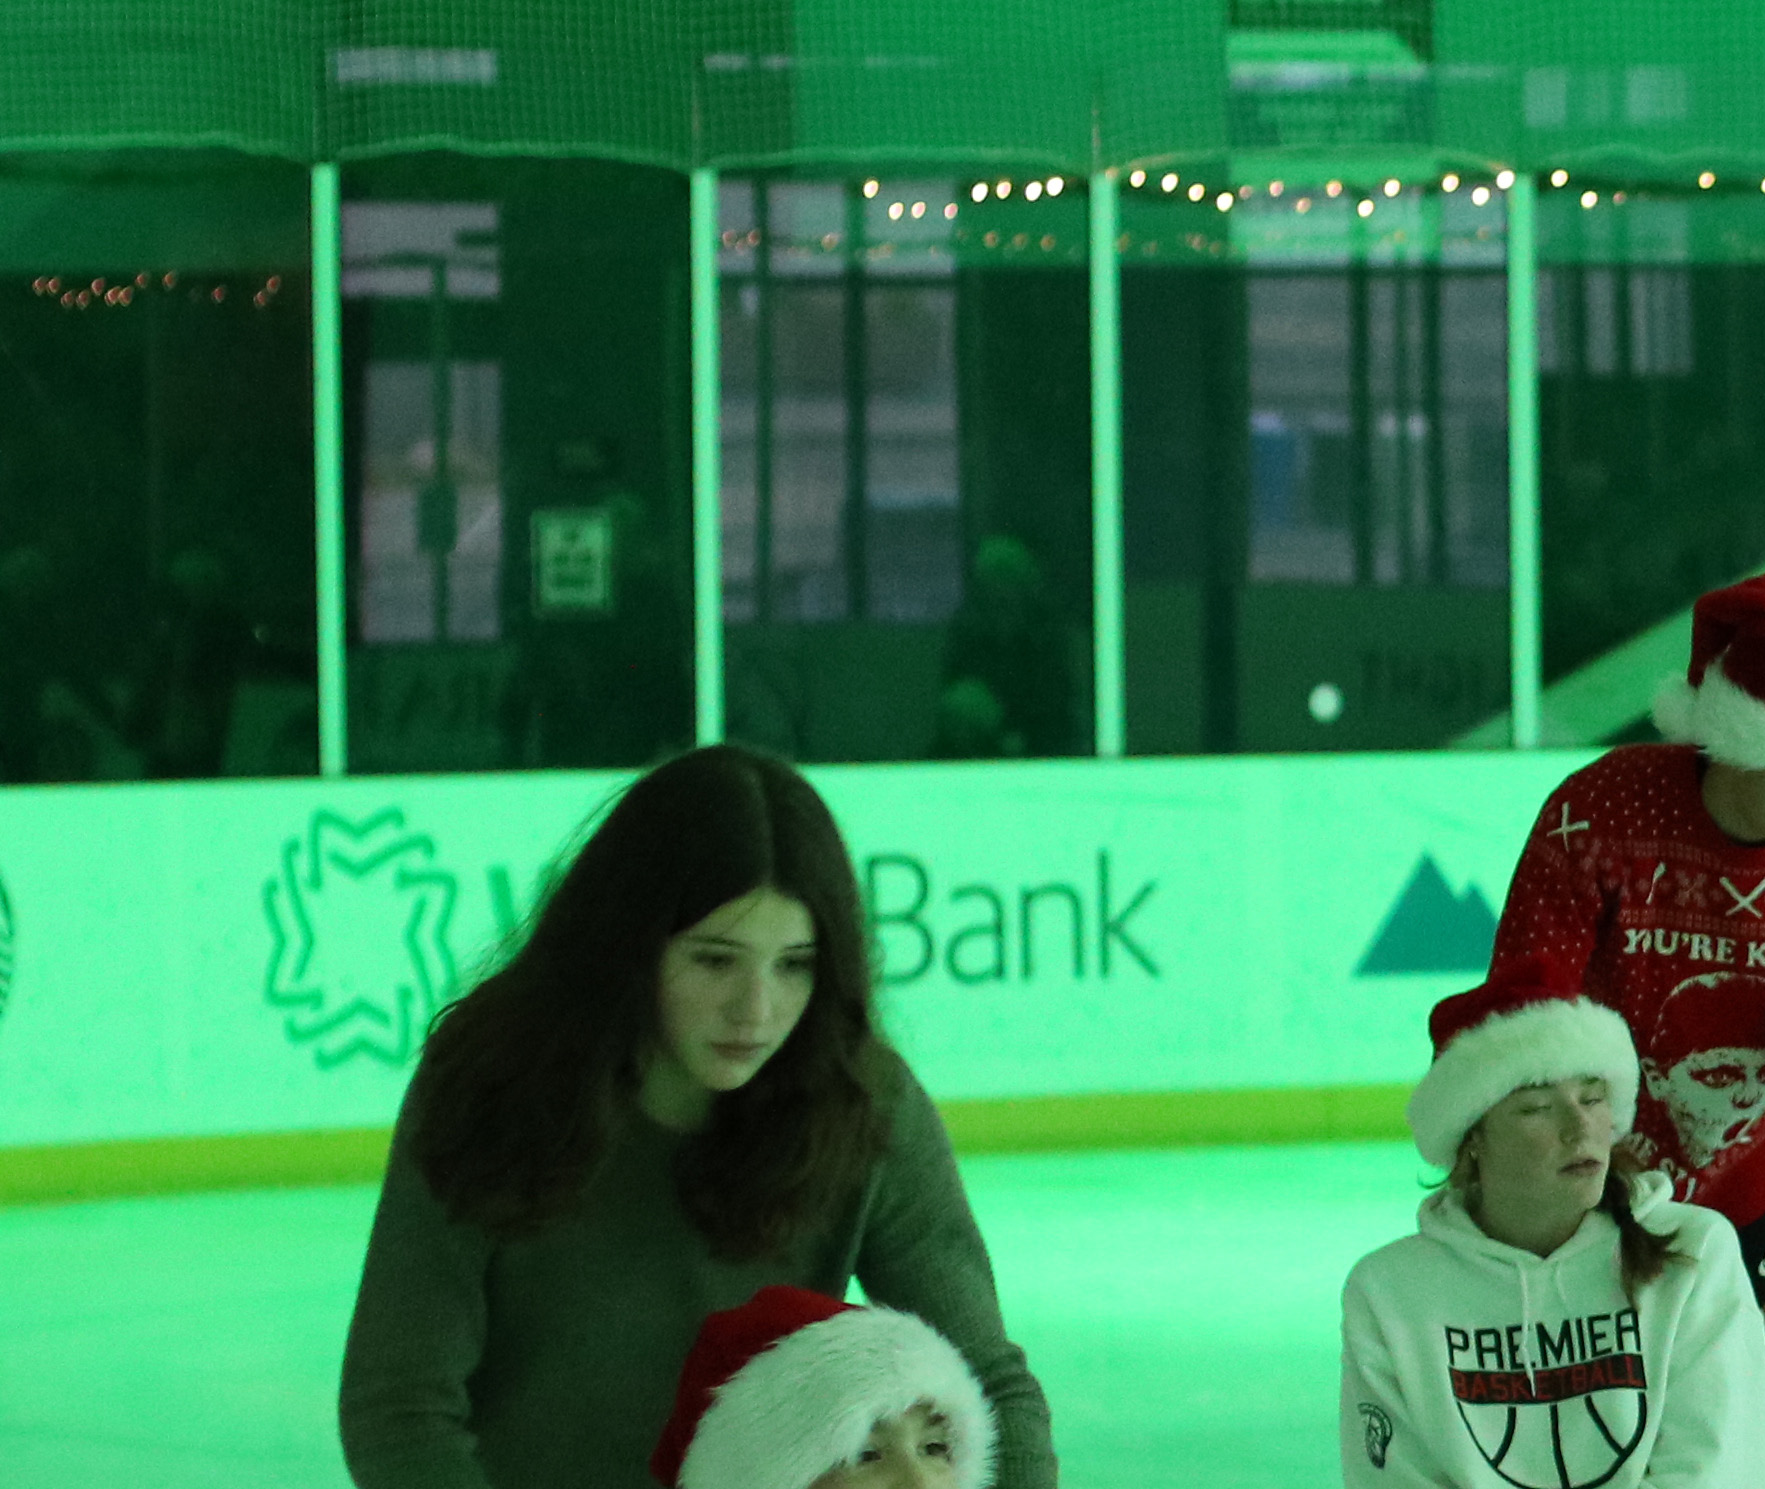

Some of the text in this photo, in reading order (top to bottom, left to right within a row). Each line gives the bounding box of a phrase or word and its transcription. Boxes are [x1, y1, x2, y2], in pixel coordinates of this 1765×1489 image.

[866, 848, 1160, 985] Bank
[1445, 1307, 1642, 1370] PREMIER
[1453, 1355, 1646, 1401] BASKETBALL
